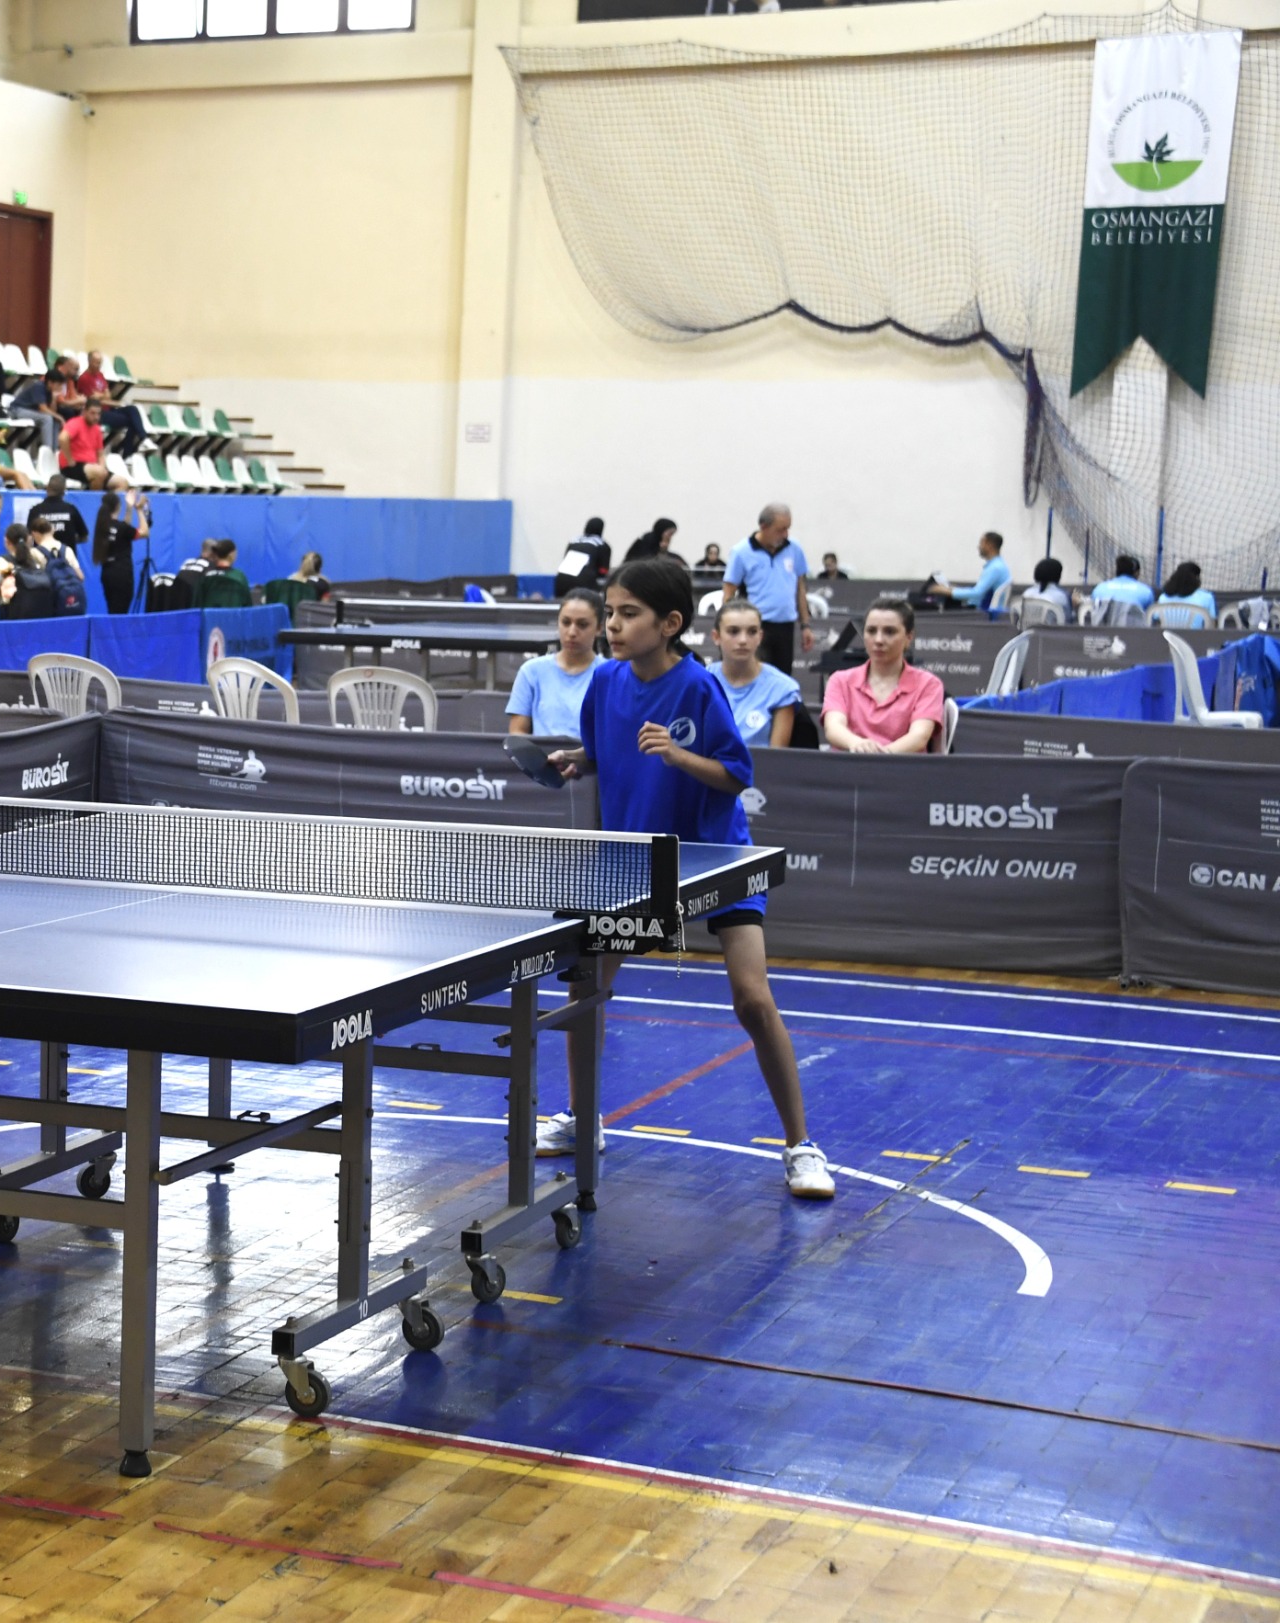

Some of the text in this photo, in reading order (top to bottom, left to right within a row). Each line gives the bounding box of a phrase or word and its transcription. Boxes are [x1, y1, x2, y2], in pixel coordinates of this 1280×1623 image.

[1091, 206, 1214, 229] OSMANGAZİ
[1091, 227, 1212, 246] BELEDİYESİ
[391, 639, 421, 650] JOOLA
[909, 855, 1077, 881] SEÇKİN ONUR
[746, 870, 769, 897] JOOLA
[1216, 869, 1266, 891] CAN
[587, 915, 665, 939] JOOLA
[610, 939, 636, 951] WM
[544, 950, 556, 973] 25
[420, 980, 468, 1015] SUNTEKS
[331, 1009, 373, 1051] JOOLA
